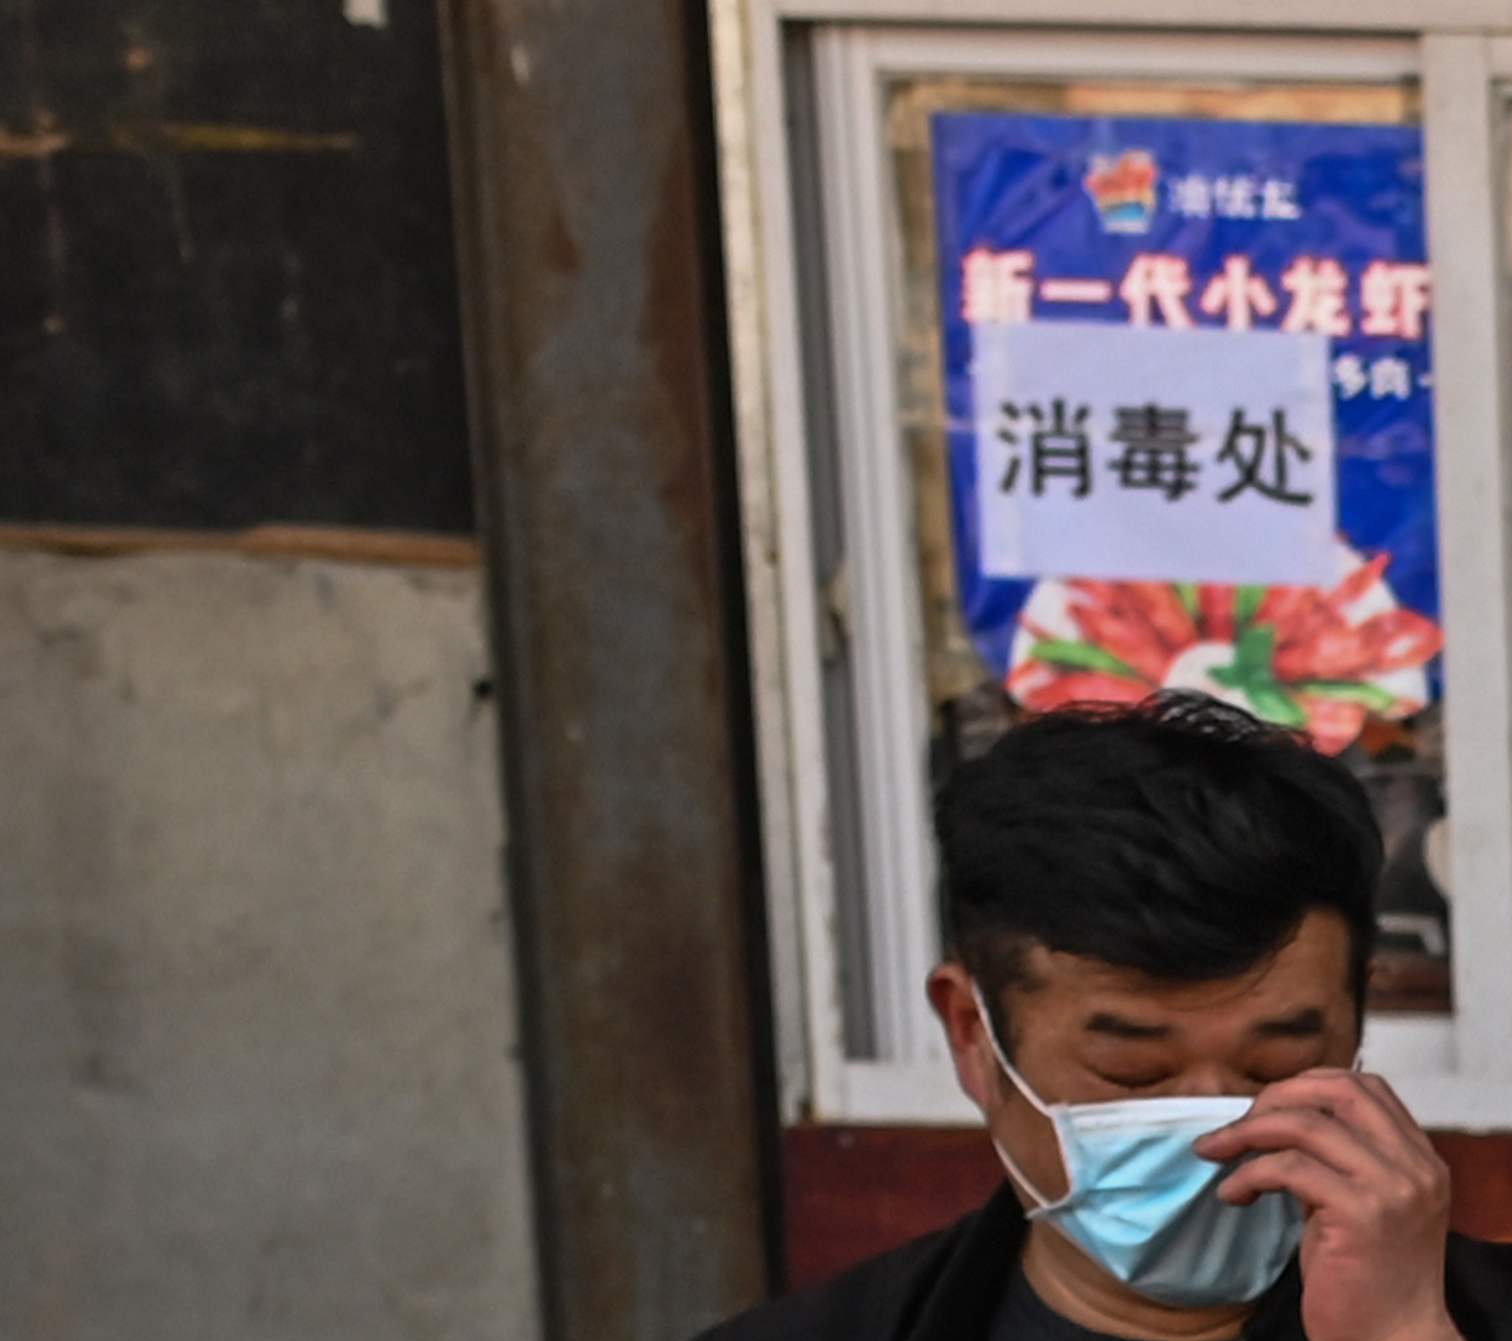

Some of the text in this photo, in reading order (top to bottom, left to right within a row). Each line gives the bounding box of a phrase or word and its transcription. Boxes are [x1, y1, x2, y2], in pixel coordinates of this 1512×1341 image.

[963, 246, 1431, 339] 新一代小龙虾
[996, 397, 1314, 507] 消毒处
